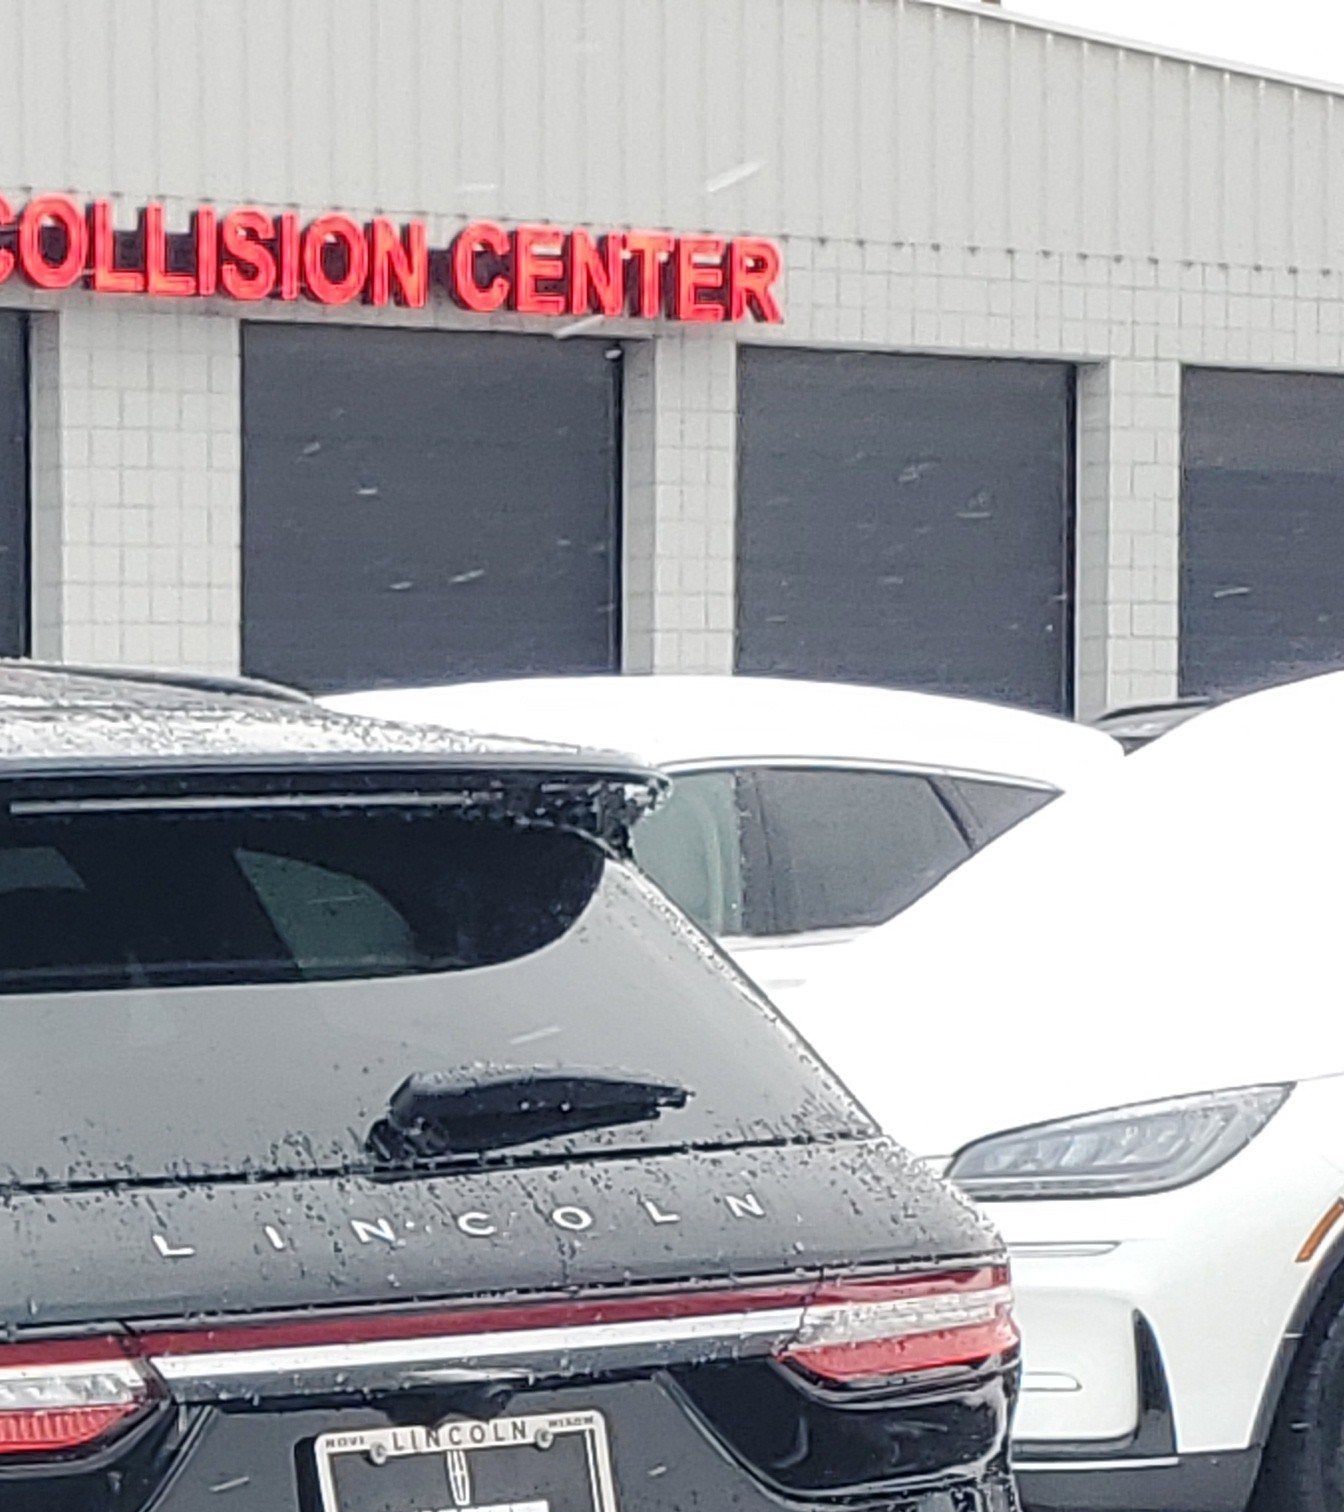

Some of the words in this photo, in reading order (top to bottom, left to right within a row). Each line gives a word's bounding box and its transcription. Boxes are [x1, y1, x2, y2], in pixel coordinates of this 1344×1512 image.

[451, 219, 785, 325] CENTER
[152, 1192, 766, 1259] LINCOLN
[391, 1419, 528, 1452] LINCOLN
